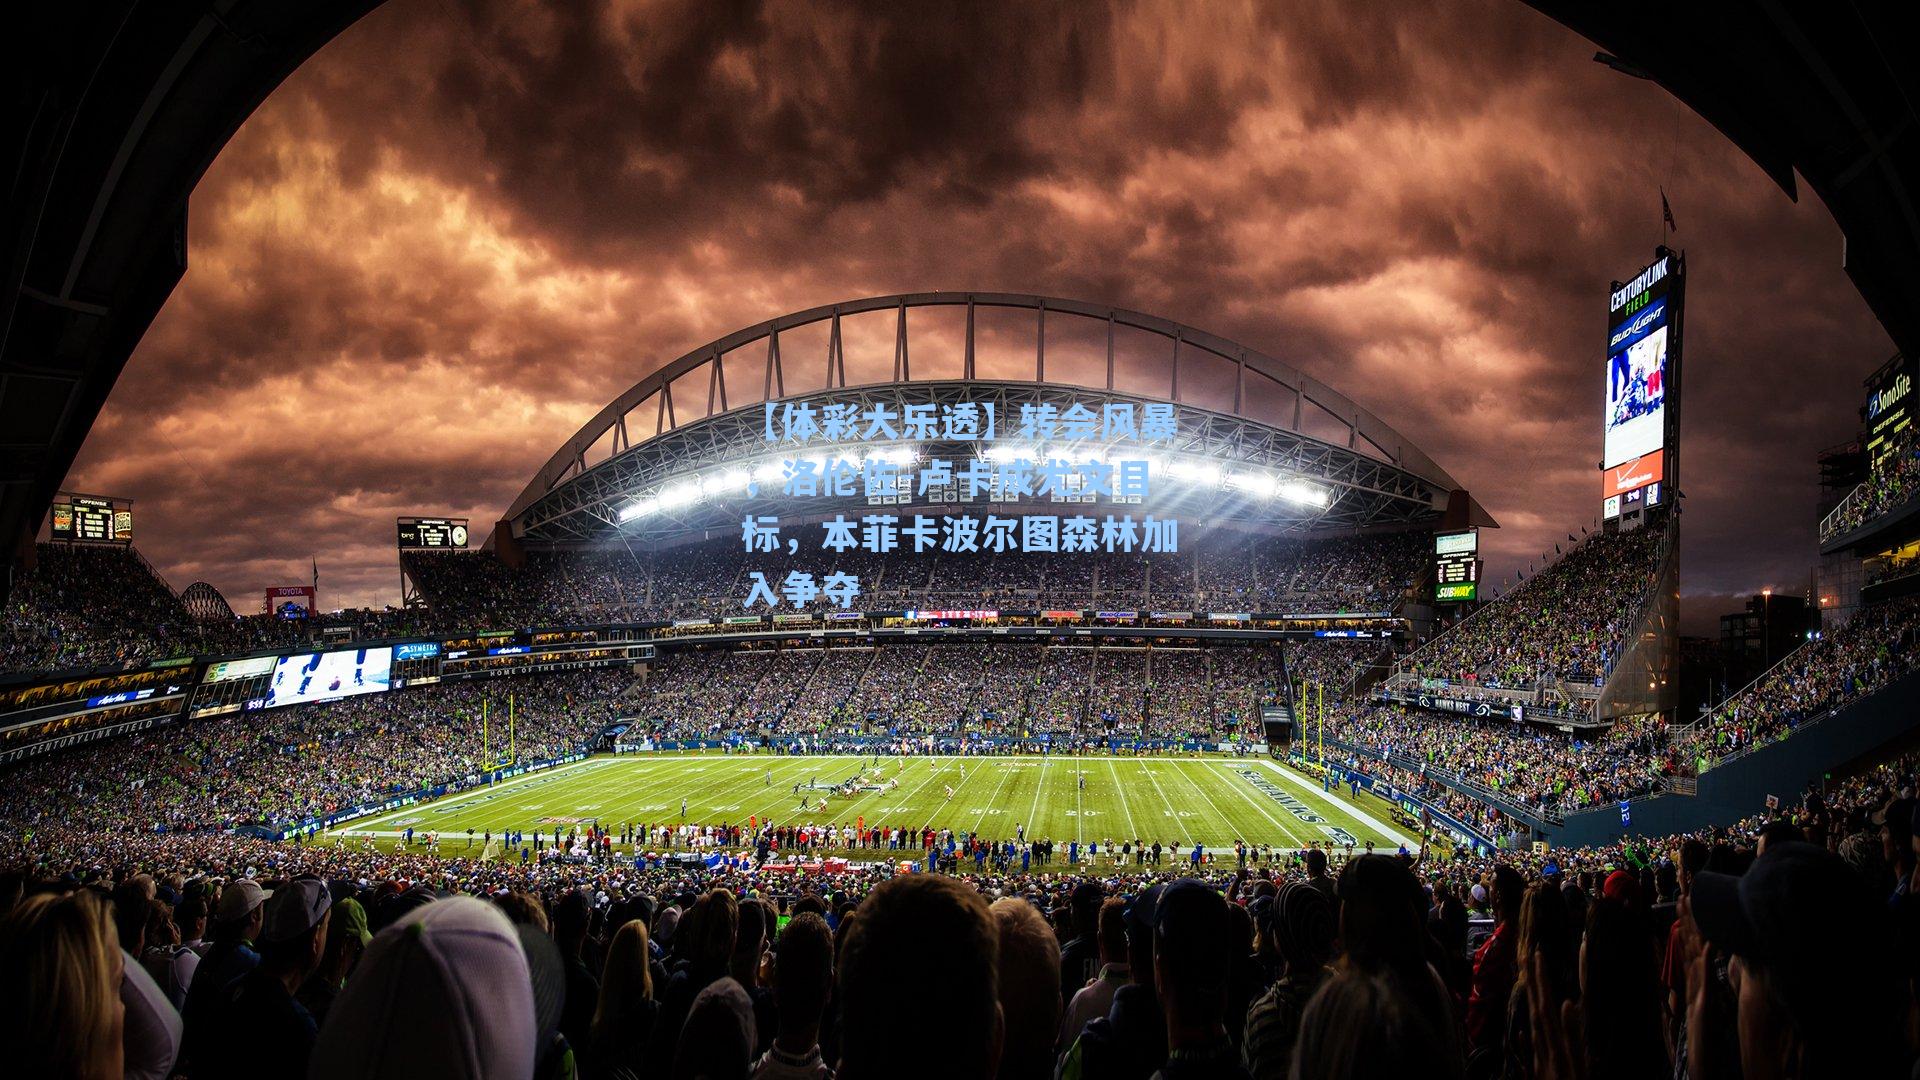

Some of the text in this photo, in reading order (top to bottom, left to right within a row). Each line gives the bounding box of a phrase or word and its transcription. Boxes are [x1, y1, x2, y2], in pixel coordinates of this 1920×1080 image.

[1610, 256, 1669, 313] CENTURYLINK
[1625, 290, 1650, 316] FIELD
[1610, 305, 1665, 347] BUD LIGHT
[1878, 373, 1912, 414] SonoSite
[1872, 407, 1905, 435] DEFENSE
[80, 499, 107, 507] OFFENSE
[401, 532, 415, 540] bing
[278, 587, 304, 596] TOYOTA
[1436, 584, 1475, 599] SUBWAY
[410, 644, 438, 653] SYMETRA
[490, 668, 516, 677] HOME
[561, 662, 583, 670] 12TH
[1455, 700, 1470, 713] NEST
[10, 720, 153, 763] TO CENTURYLINK FIELD
[1233, 769, 1329, 823] SEAHAWKS
[1620, 804, 1630, 822] 12
